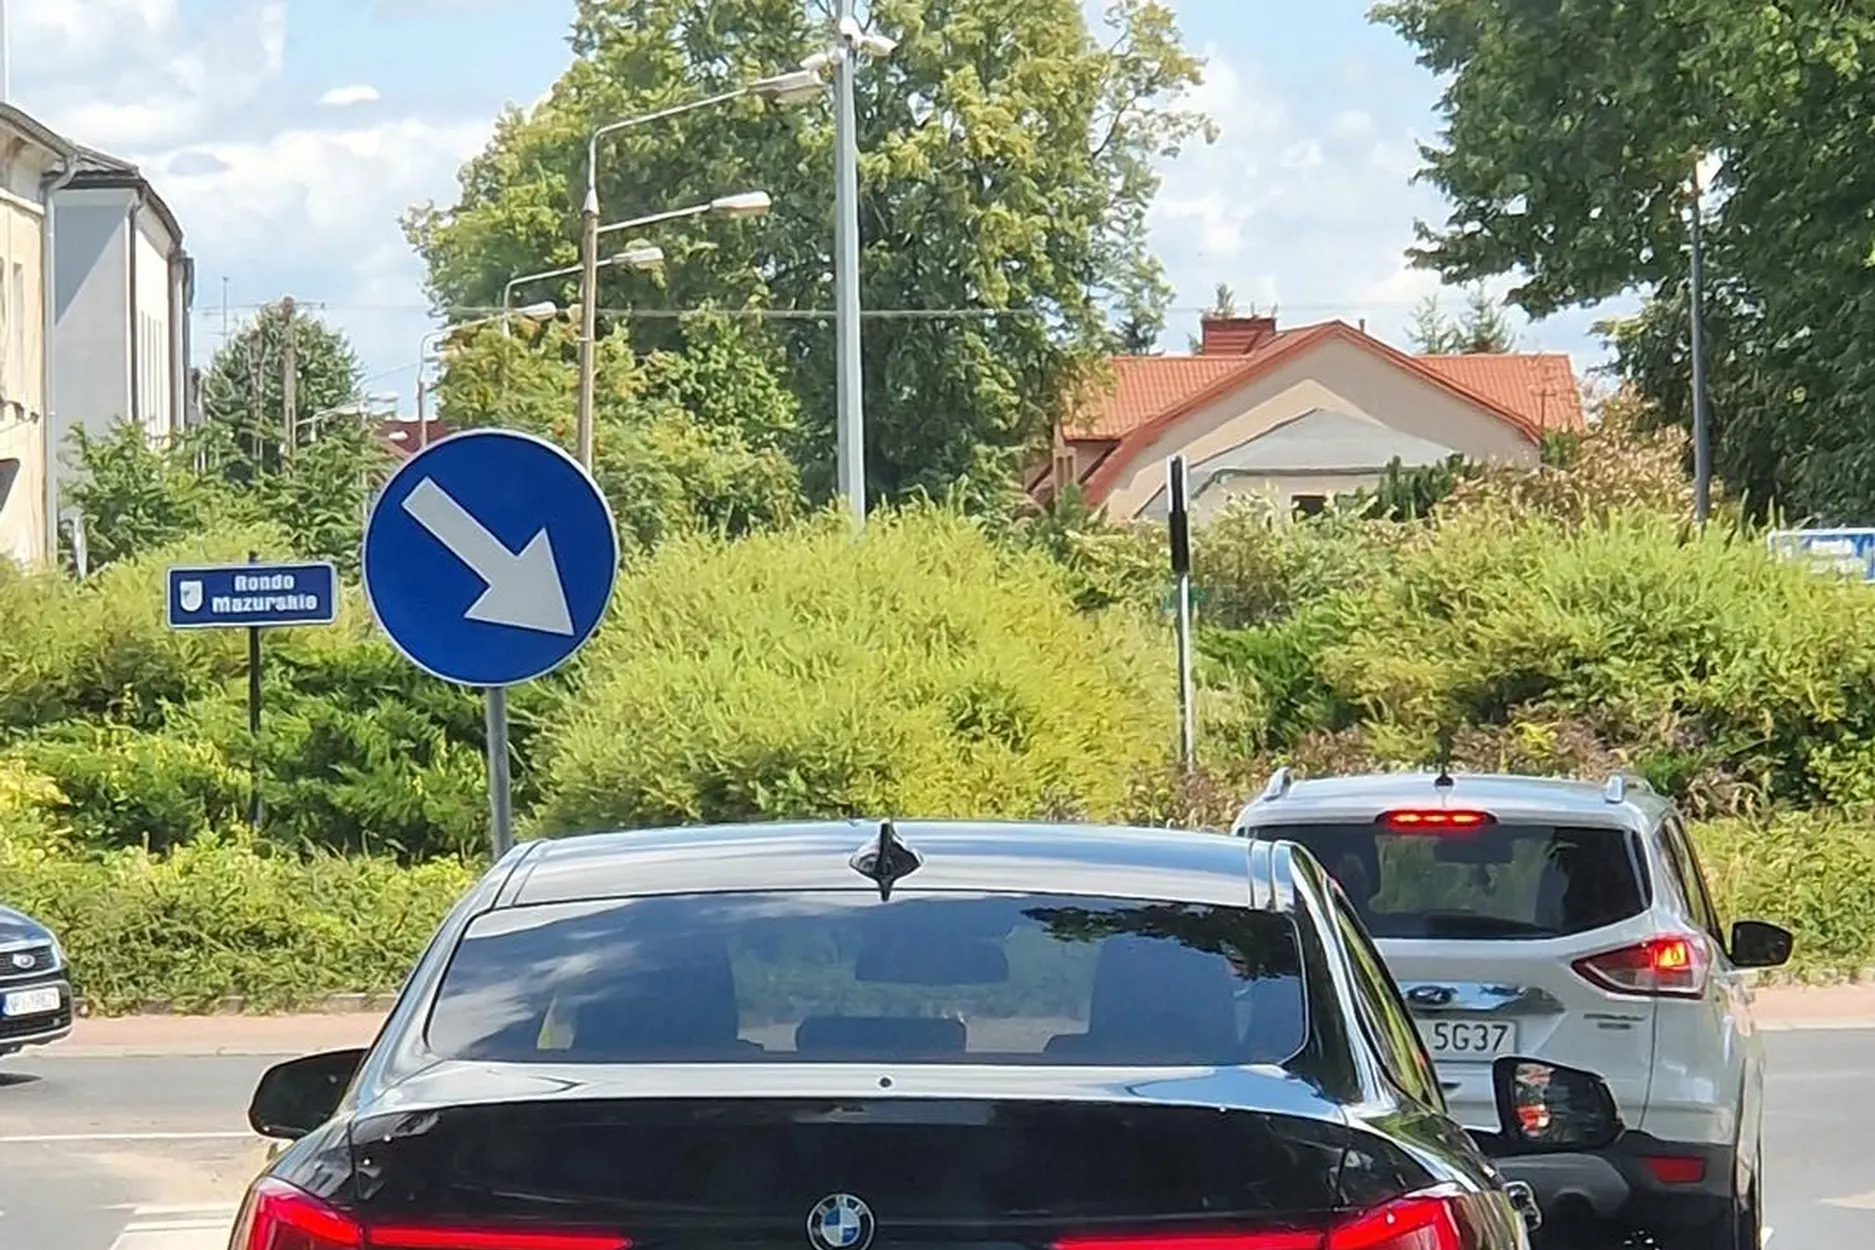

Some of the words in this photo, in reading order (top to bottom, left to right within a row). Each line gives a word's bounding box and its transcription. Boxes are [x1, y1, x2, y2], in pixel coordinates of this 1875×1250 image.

[234, 574, 295, 591] Rondo
[212, 594, 318, 612] Mazurskie
[1433, 1022, 1509, 1052] 5G37
